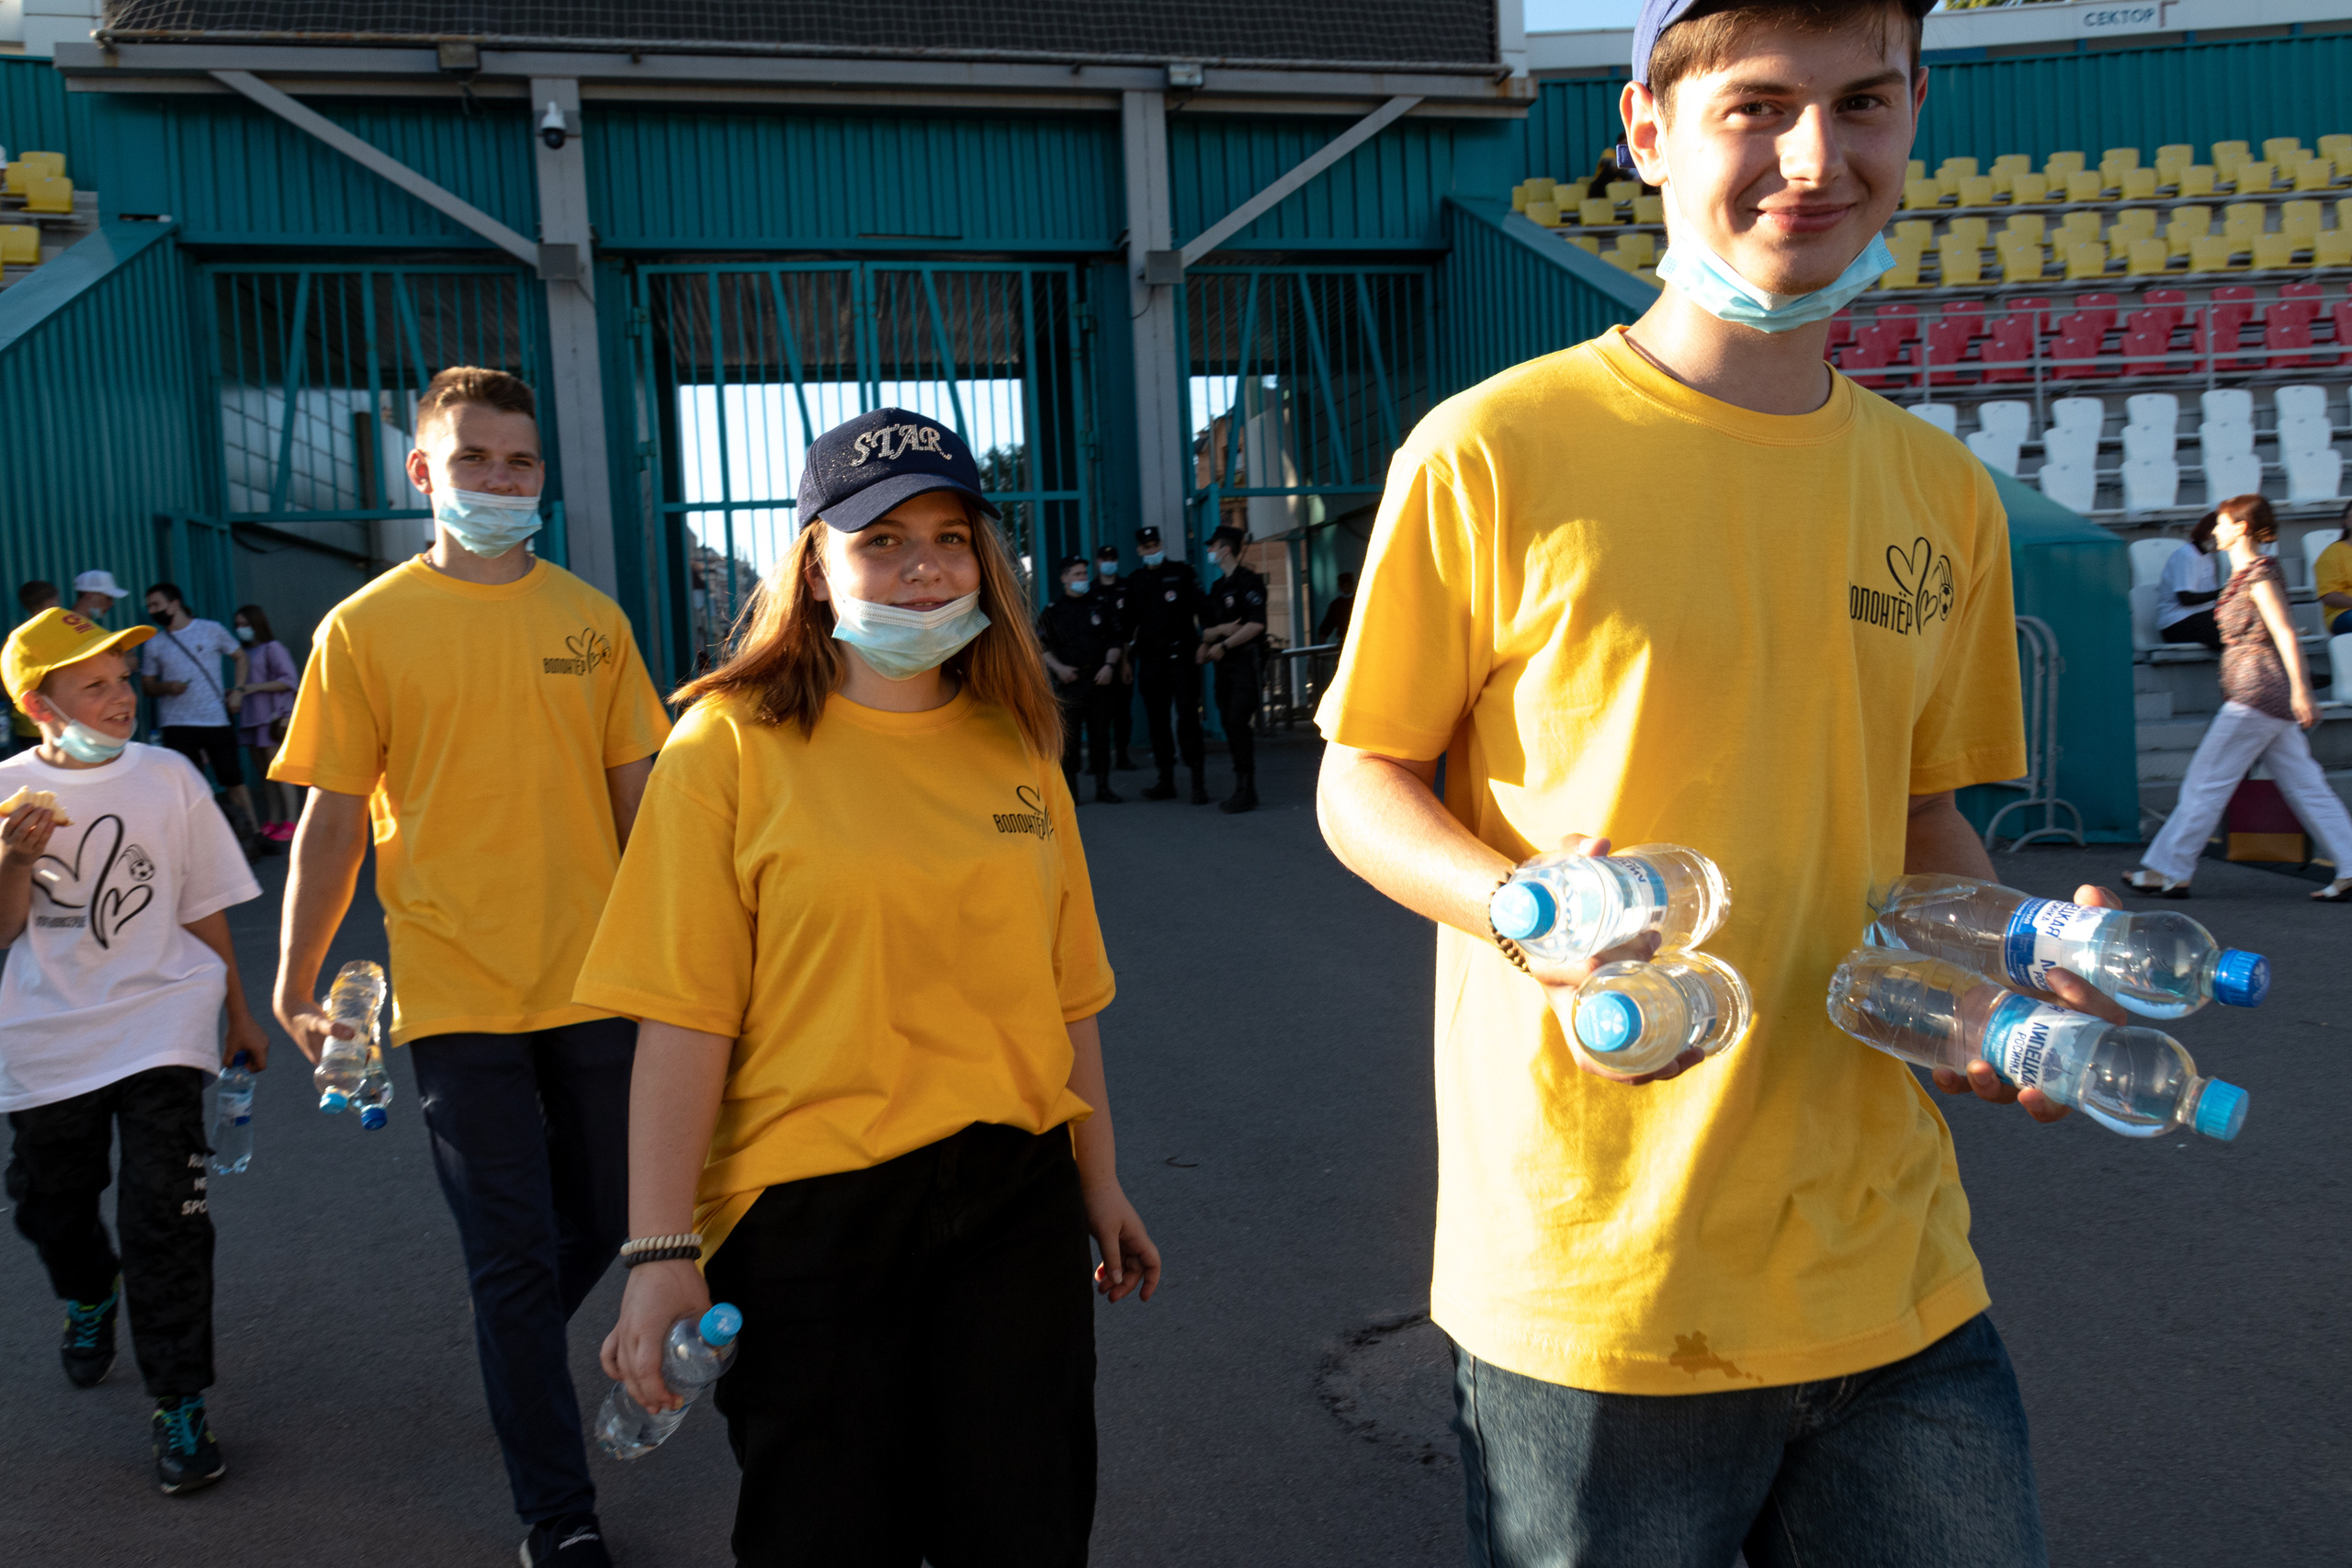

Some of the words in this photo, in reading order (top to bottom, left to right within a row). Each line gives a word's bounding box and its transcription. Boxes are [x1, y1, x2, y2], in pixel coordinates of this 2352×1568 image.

[2083, 7, 2156, 27] СЕКТОР
[851, 423, 953, 468] STAR
[1849, 581, 1913, 636] ОЛОНТЁР
[2045, 903, 2081, 938] ЕЦКАЯ
[2008, 1031, 2027, 1076] РОСИНКА
[181, 1200, 208, 1215] SPO
